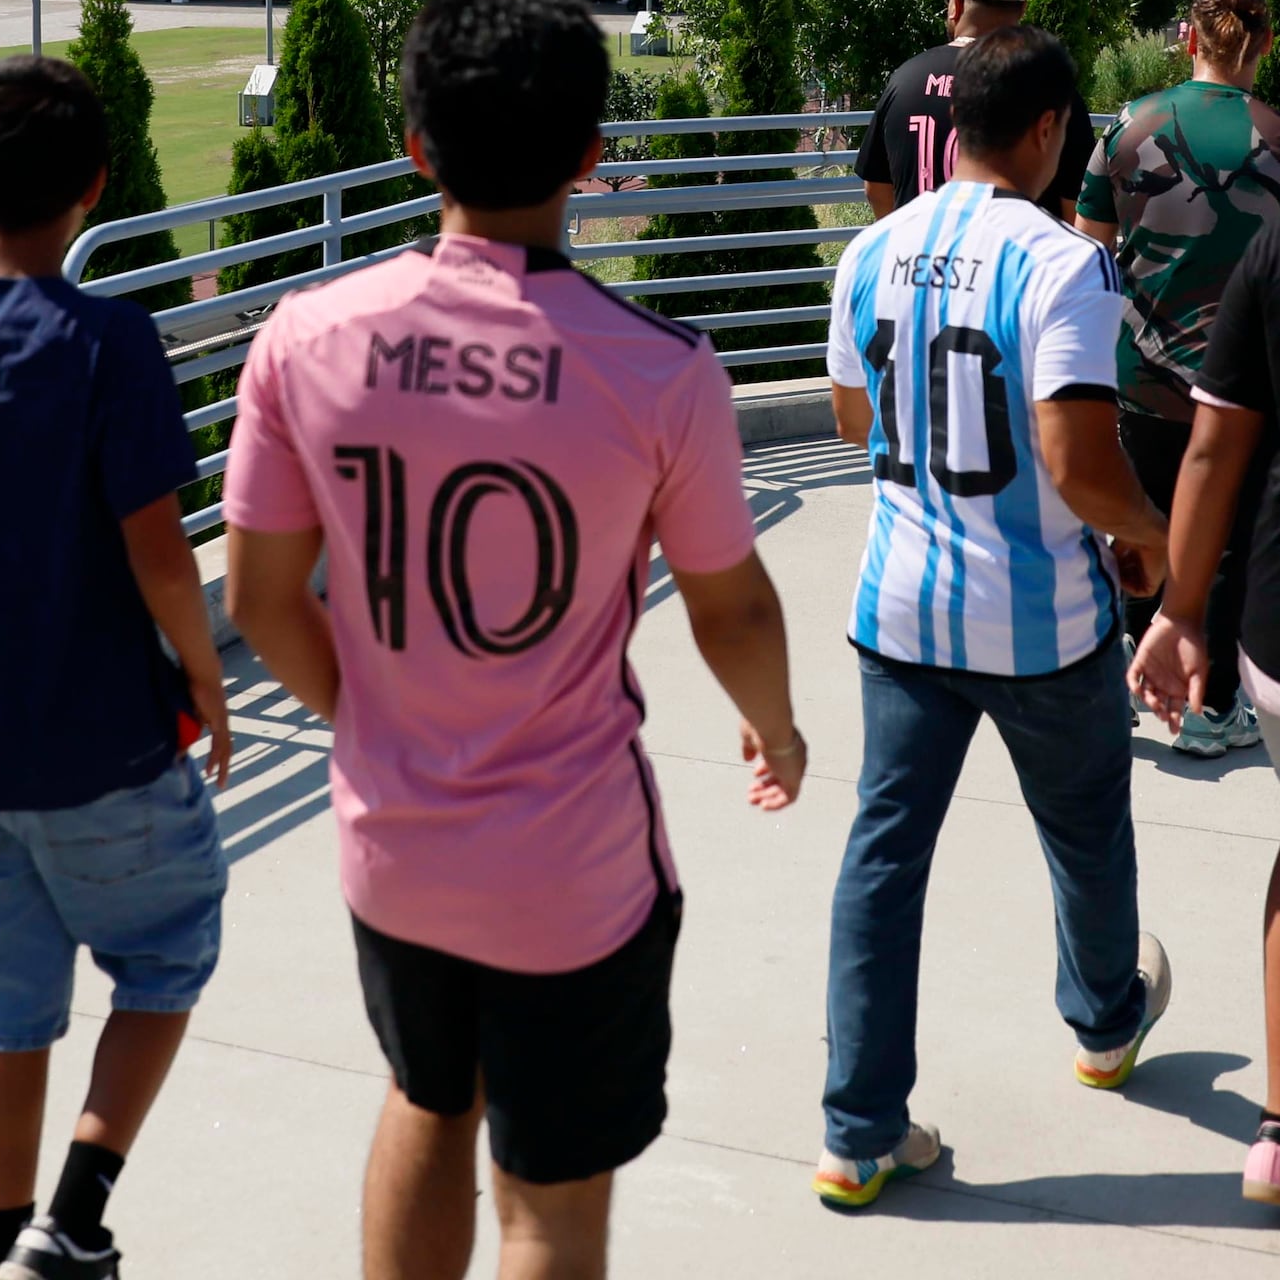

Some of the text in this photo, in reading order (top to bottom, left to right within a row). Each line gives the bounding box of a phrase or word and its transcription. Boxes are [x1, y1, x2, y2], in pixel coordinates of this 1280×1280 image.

[891, 254, 983, 292] MESSI
[365, 331, 563, 405] MESSI
[865, 318, 1018, 498] 10
[332, 444, 581, 661] 10
